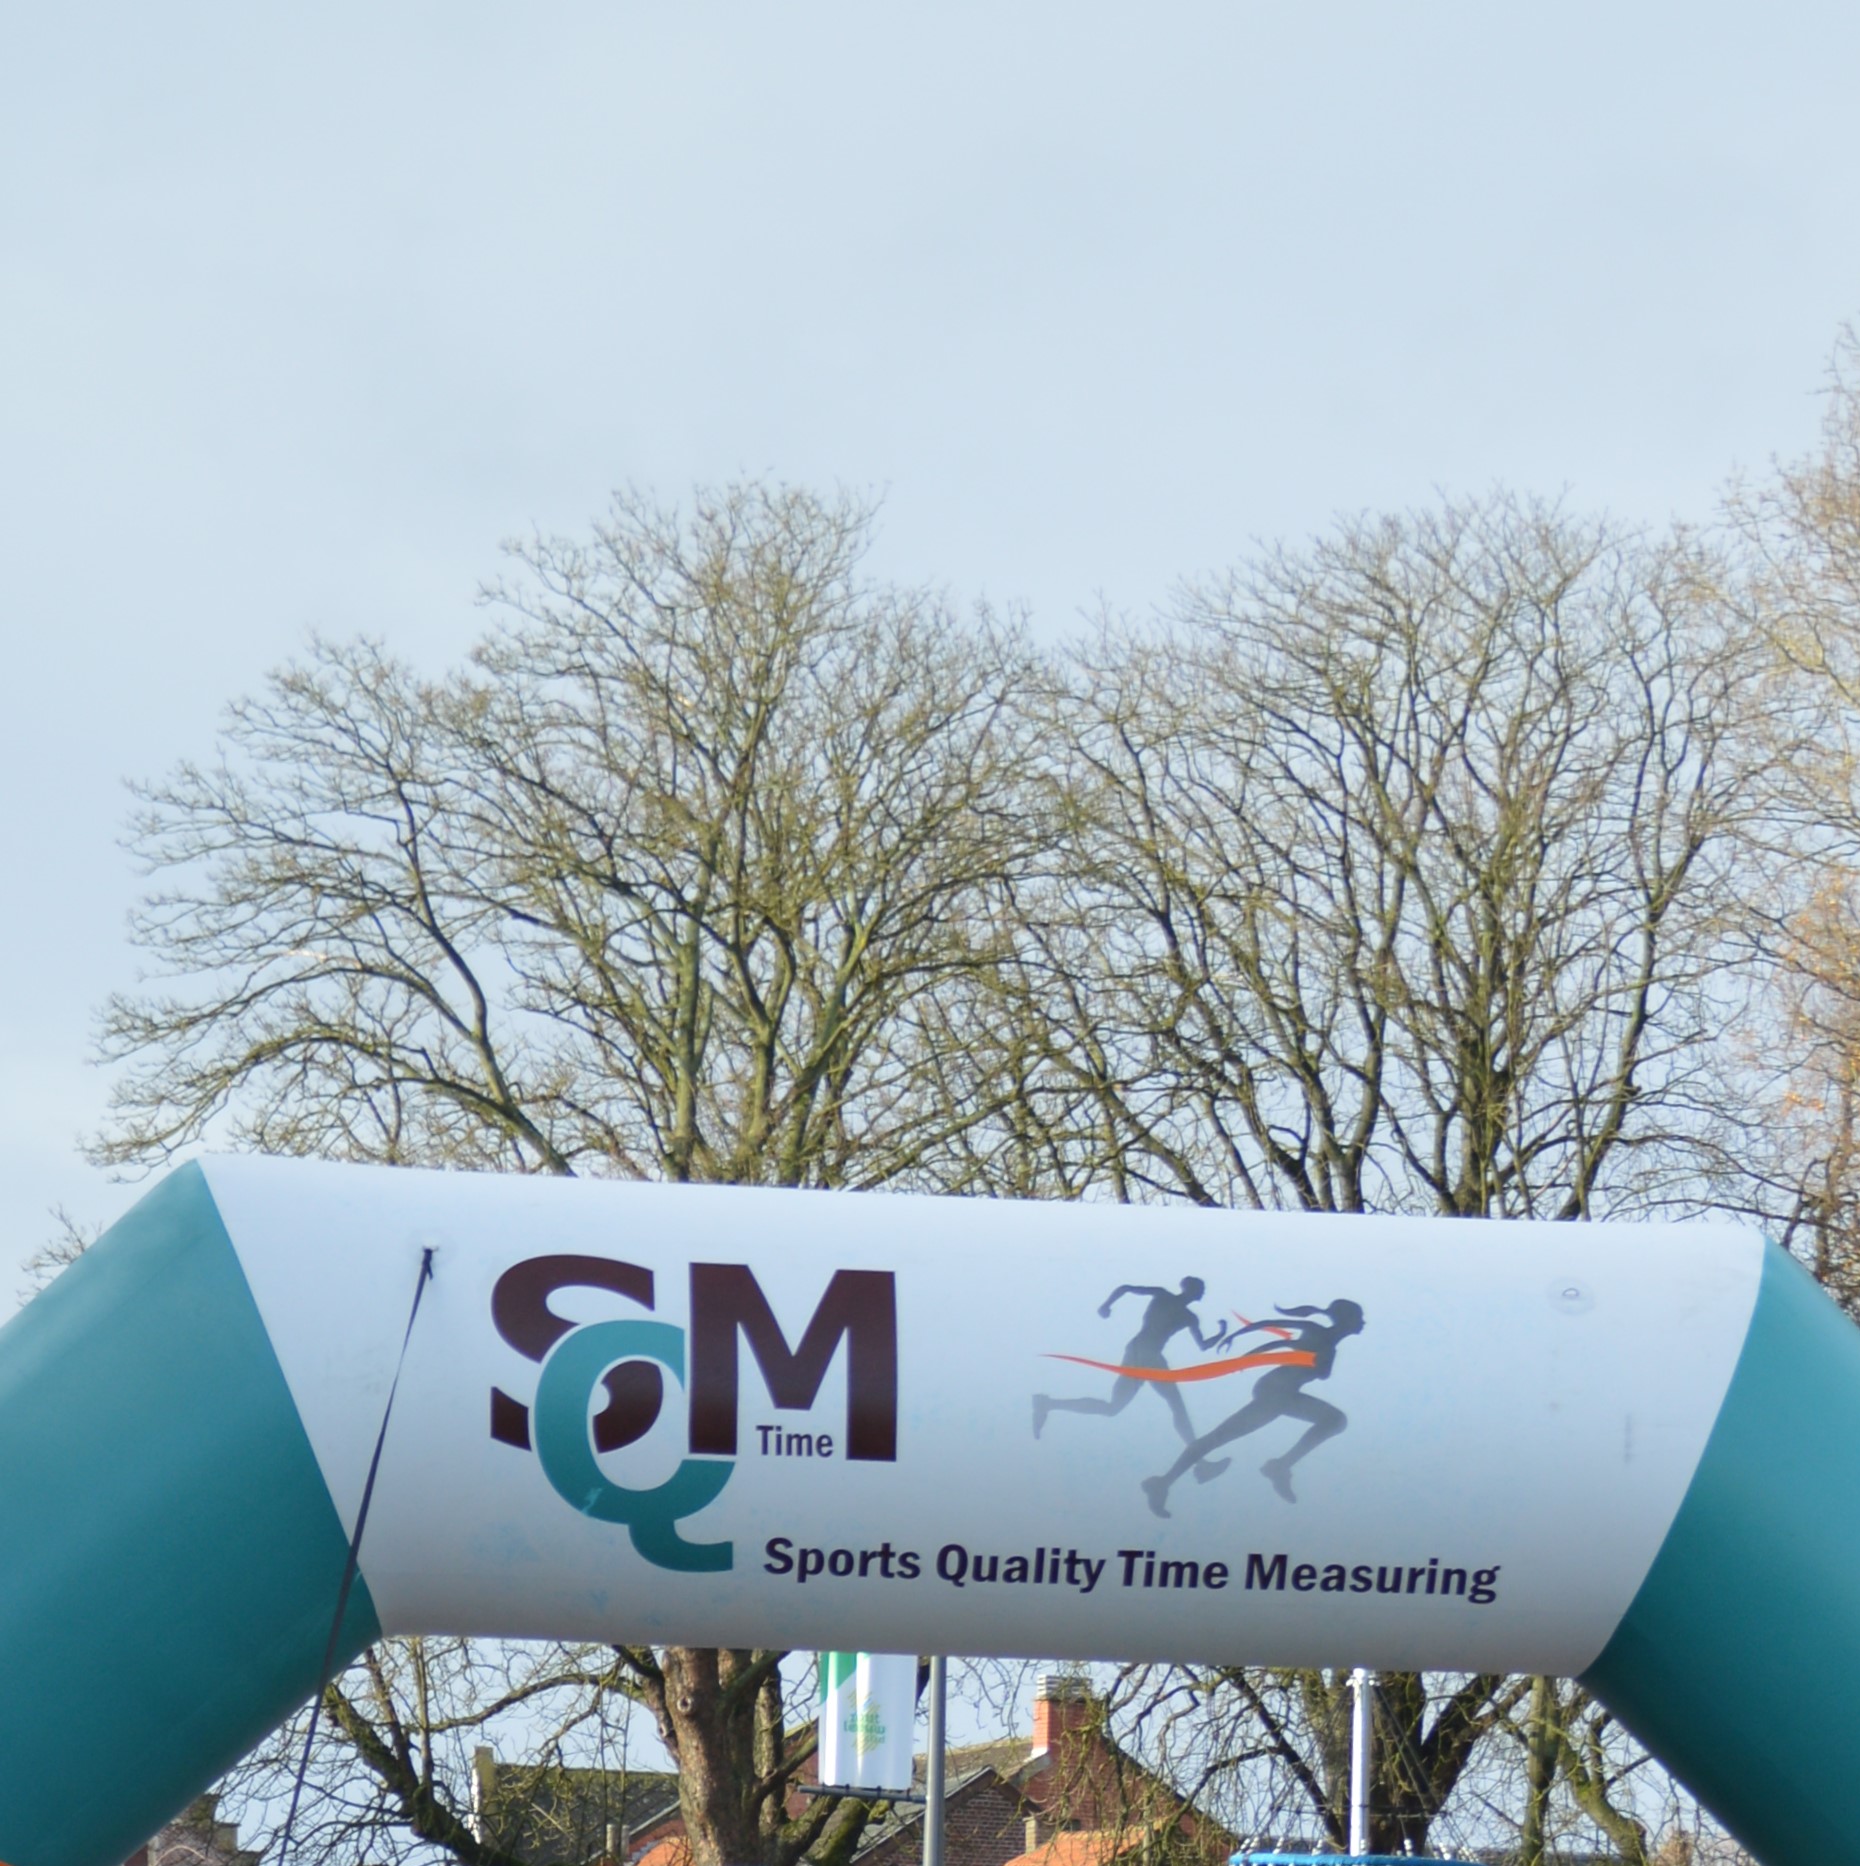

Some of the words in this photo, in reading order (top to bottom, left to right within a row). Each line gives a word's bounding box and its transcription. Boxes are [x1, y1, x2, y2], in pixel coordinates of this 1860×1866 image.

[756, 1425, 835, 1458] Time
[763, 1536, 922, 1583] Sports
[935, 1544, 1105, 1593] Quality
[1117, 1549, 1230, 1590] Time
[1244, 1553, 1502, 1604] Measuring
